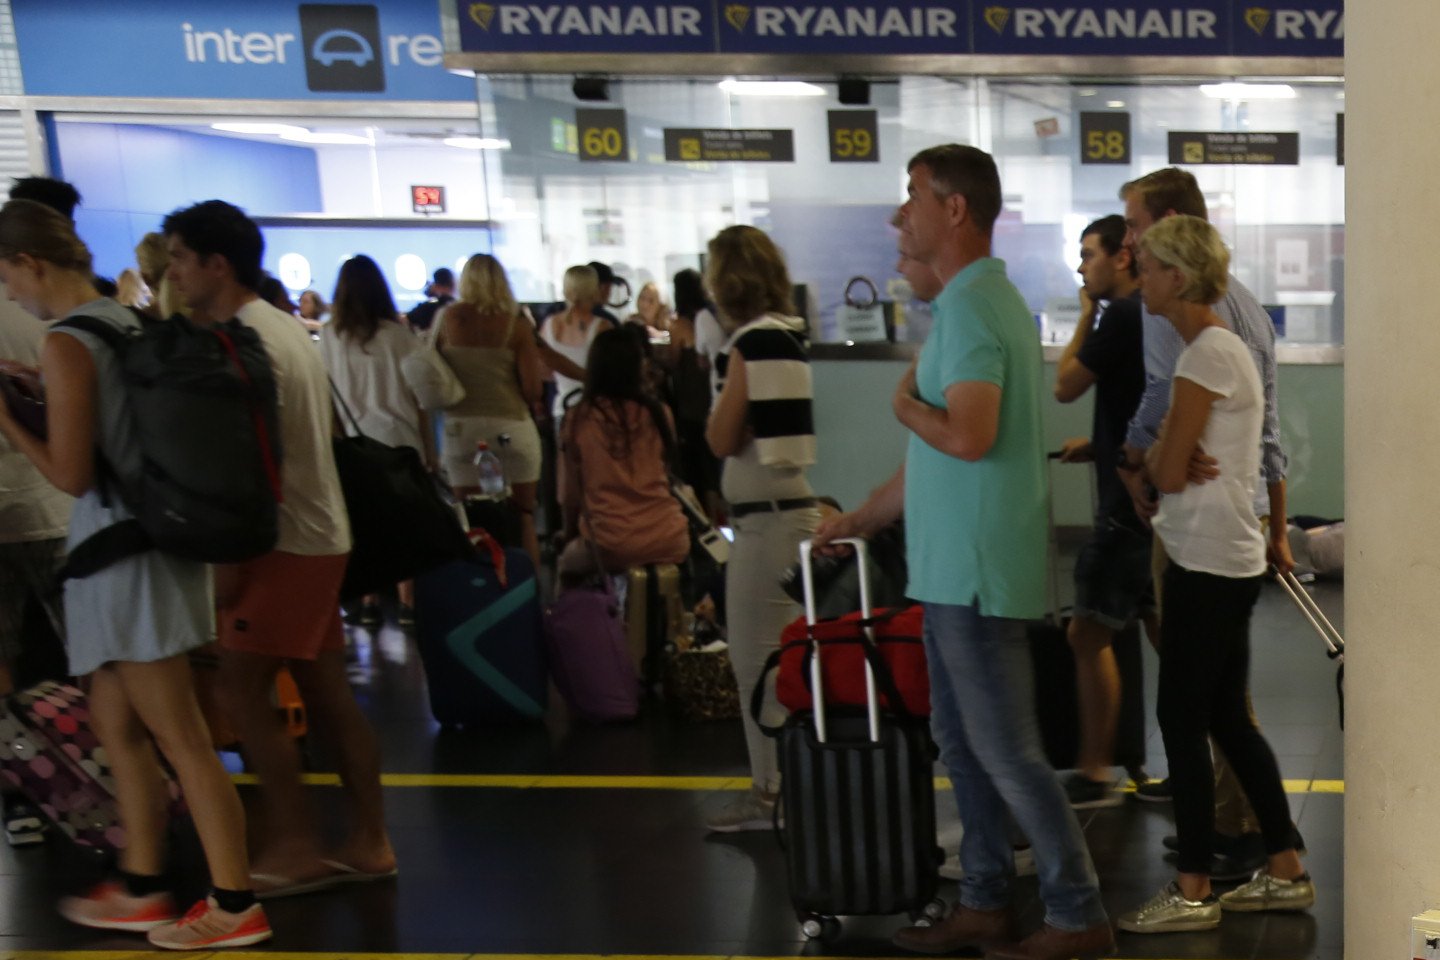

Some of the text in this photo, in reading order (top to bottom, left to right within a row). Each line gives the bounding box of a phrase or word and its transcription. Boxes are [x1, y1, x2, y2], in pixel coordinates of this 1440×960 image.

[499, 5, 702, 35] RYANAIR
[755, 6, 957, 37] RYANAIR
[1014, 8, 1217, 38] RYANAIR
[181, 22, 295, 65] inter
[387, 34, 445, 67] re
[582, 126, 623, 157] 60
[834, 128, 873, 157] 59
[1086, 130, 1126, 159] 58
